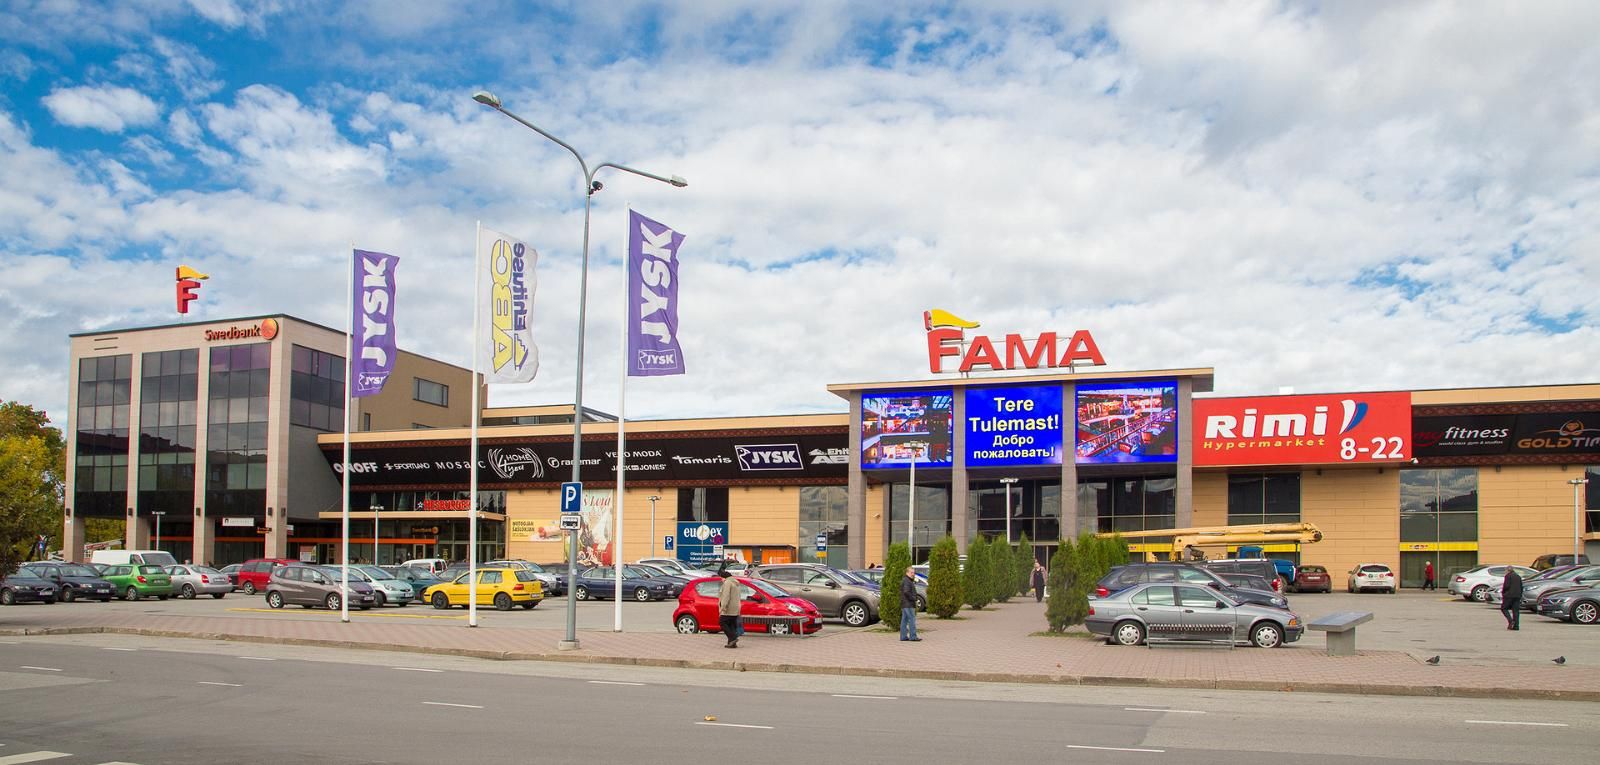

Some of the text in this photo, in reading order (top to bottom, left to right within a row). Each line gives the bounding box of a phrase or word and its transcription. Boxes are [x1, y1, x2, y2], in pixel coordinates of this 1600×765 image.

[640, 222, 673, 345] JYSK
[176, 280, 201, 313] F
[361, 257, 389, 368] JYSK
[204, 324, 261, 341] Swedbank
[927, 329, 1107, 373] FAMA
[646, 355, 675, 365] JYSK
[993, 396, 1035, 412] Tere
[968, 413, 1059, 433] Tulemast!
[1205, 405, 1329, 439] Rimi
[992, 434, 1034, 447] Добро
[1444, 426, 1509, 439] fitness
[1203, 438, 1326, 450] Hypermarket
[1340, 436, 1404, 460] 8-22
[751, 450, 798, 464] JYSK
[973, 446, 1055, 459] пожаловать!
[435, 460, 486, 469] Mosac
[560, 458, 601, 466] ramar
[565, 486, 576, 510] P
